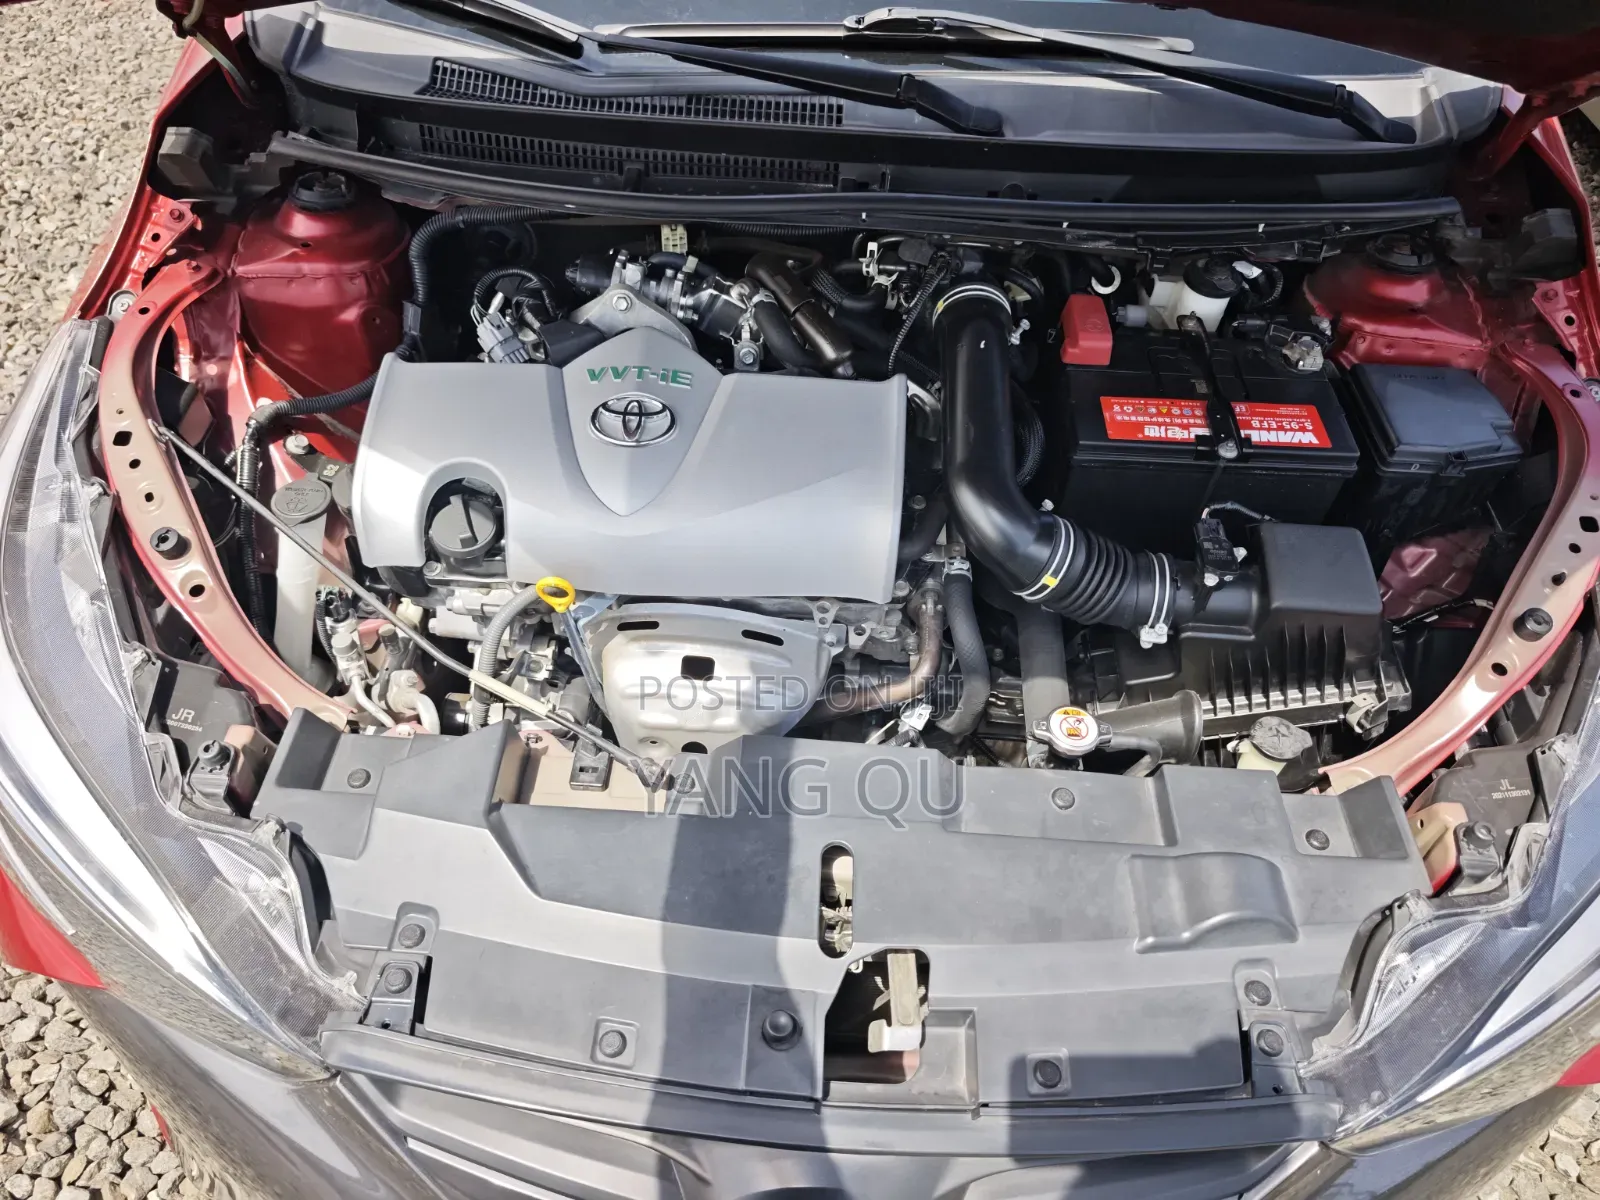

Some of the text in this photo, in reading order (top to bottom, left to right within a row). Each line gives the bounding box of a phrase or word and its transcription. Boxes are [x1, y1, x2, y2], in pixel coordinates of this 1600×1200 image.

[1251, 420, 1313, 430] S-95-EFB
[1240, 430, 1319, 444] WANL
[171, 708, 195, 722] JR
[1499, 779, 1516, 790] JL
